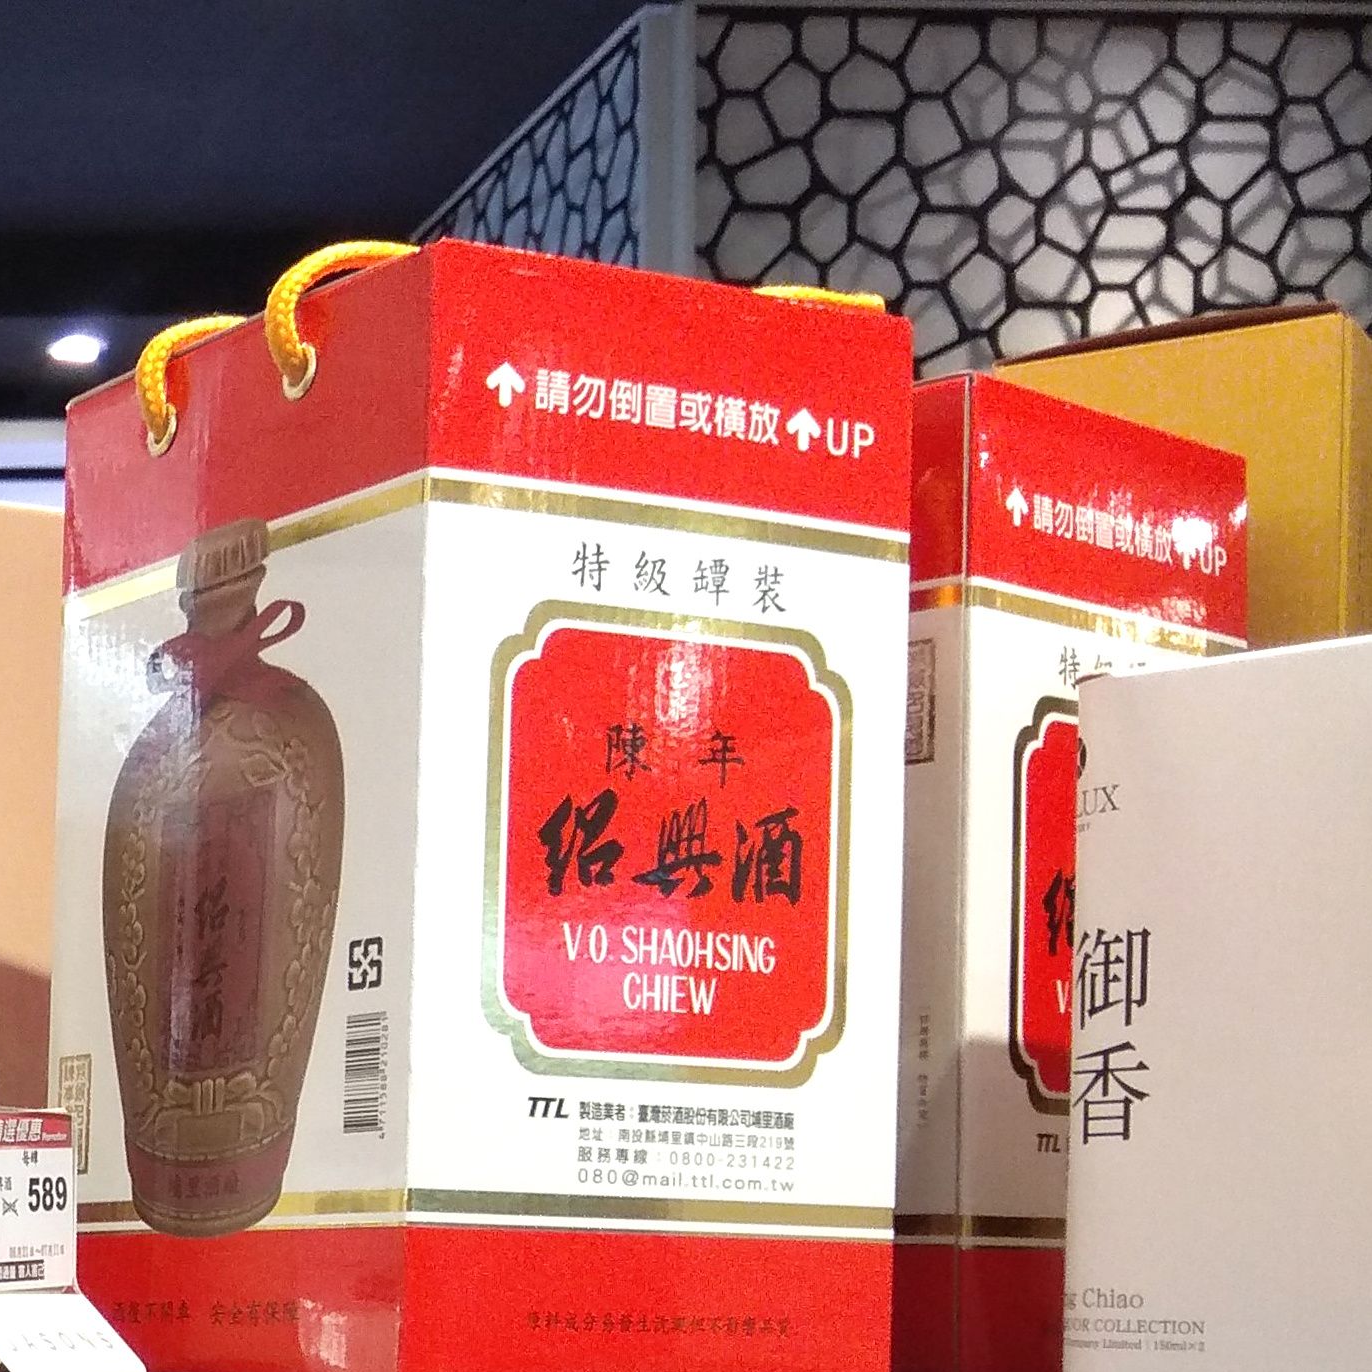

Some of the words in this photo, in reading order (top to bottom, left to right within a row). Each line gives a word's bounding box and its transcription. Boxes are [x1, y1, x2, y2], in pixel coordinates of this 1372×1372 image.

[534, 367, 781, 446] 請勿倒置或橫放
[825, 421, 875, 460] UP
[1033, 494, 1174, 566] 請勿倒置或橫放
[605, 723, 744, 789] 陳年
[538, 786, 803, 907] 紹興酒
[621, 927, 776, 974] SHAOHSING
[622, 973, 717, 1015] CHIEW
[1072, 927, 1151, 1145] 御香
[527, 1096, 570, 1119] TTL
[28, 1176, 68, 1212] 589
[1082, 1287, 1144, 1309] Chiao
[1094, 1318, 1206, 1335] COLLECTION
